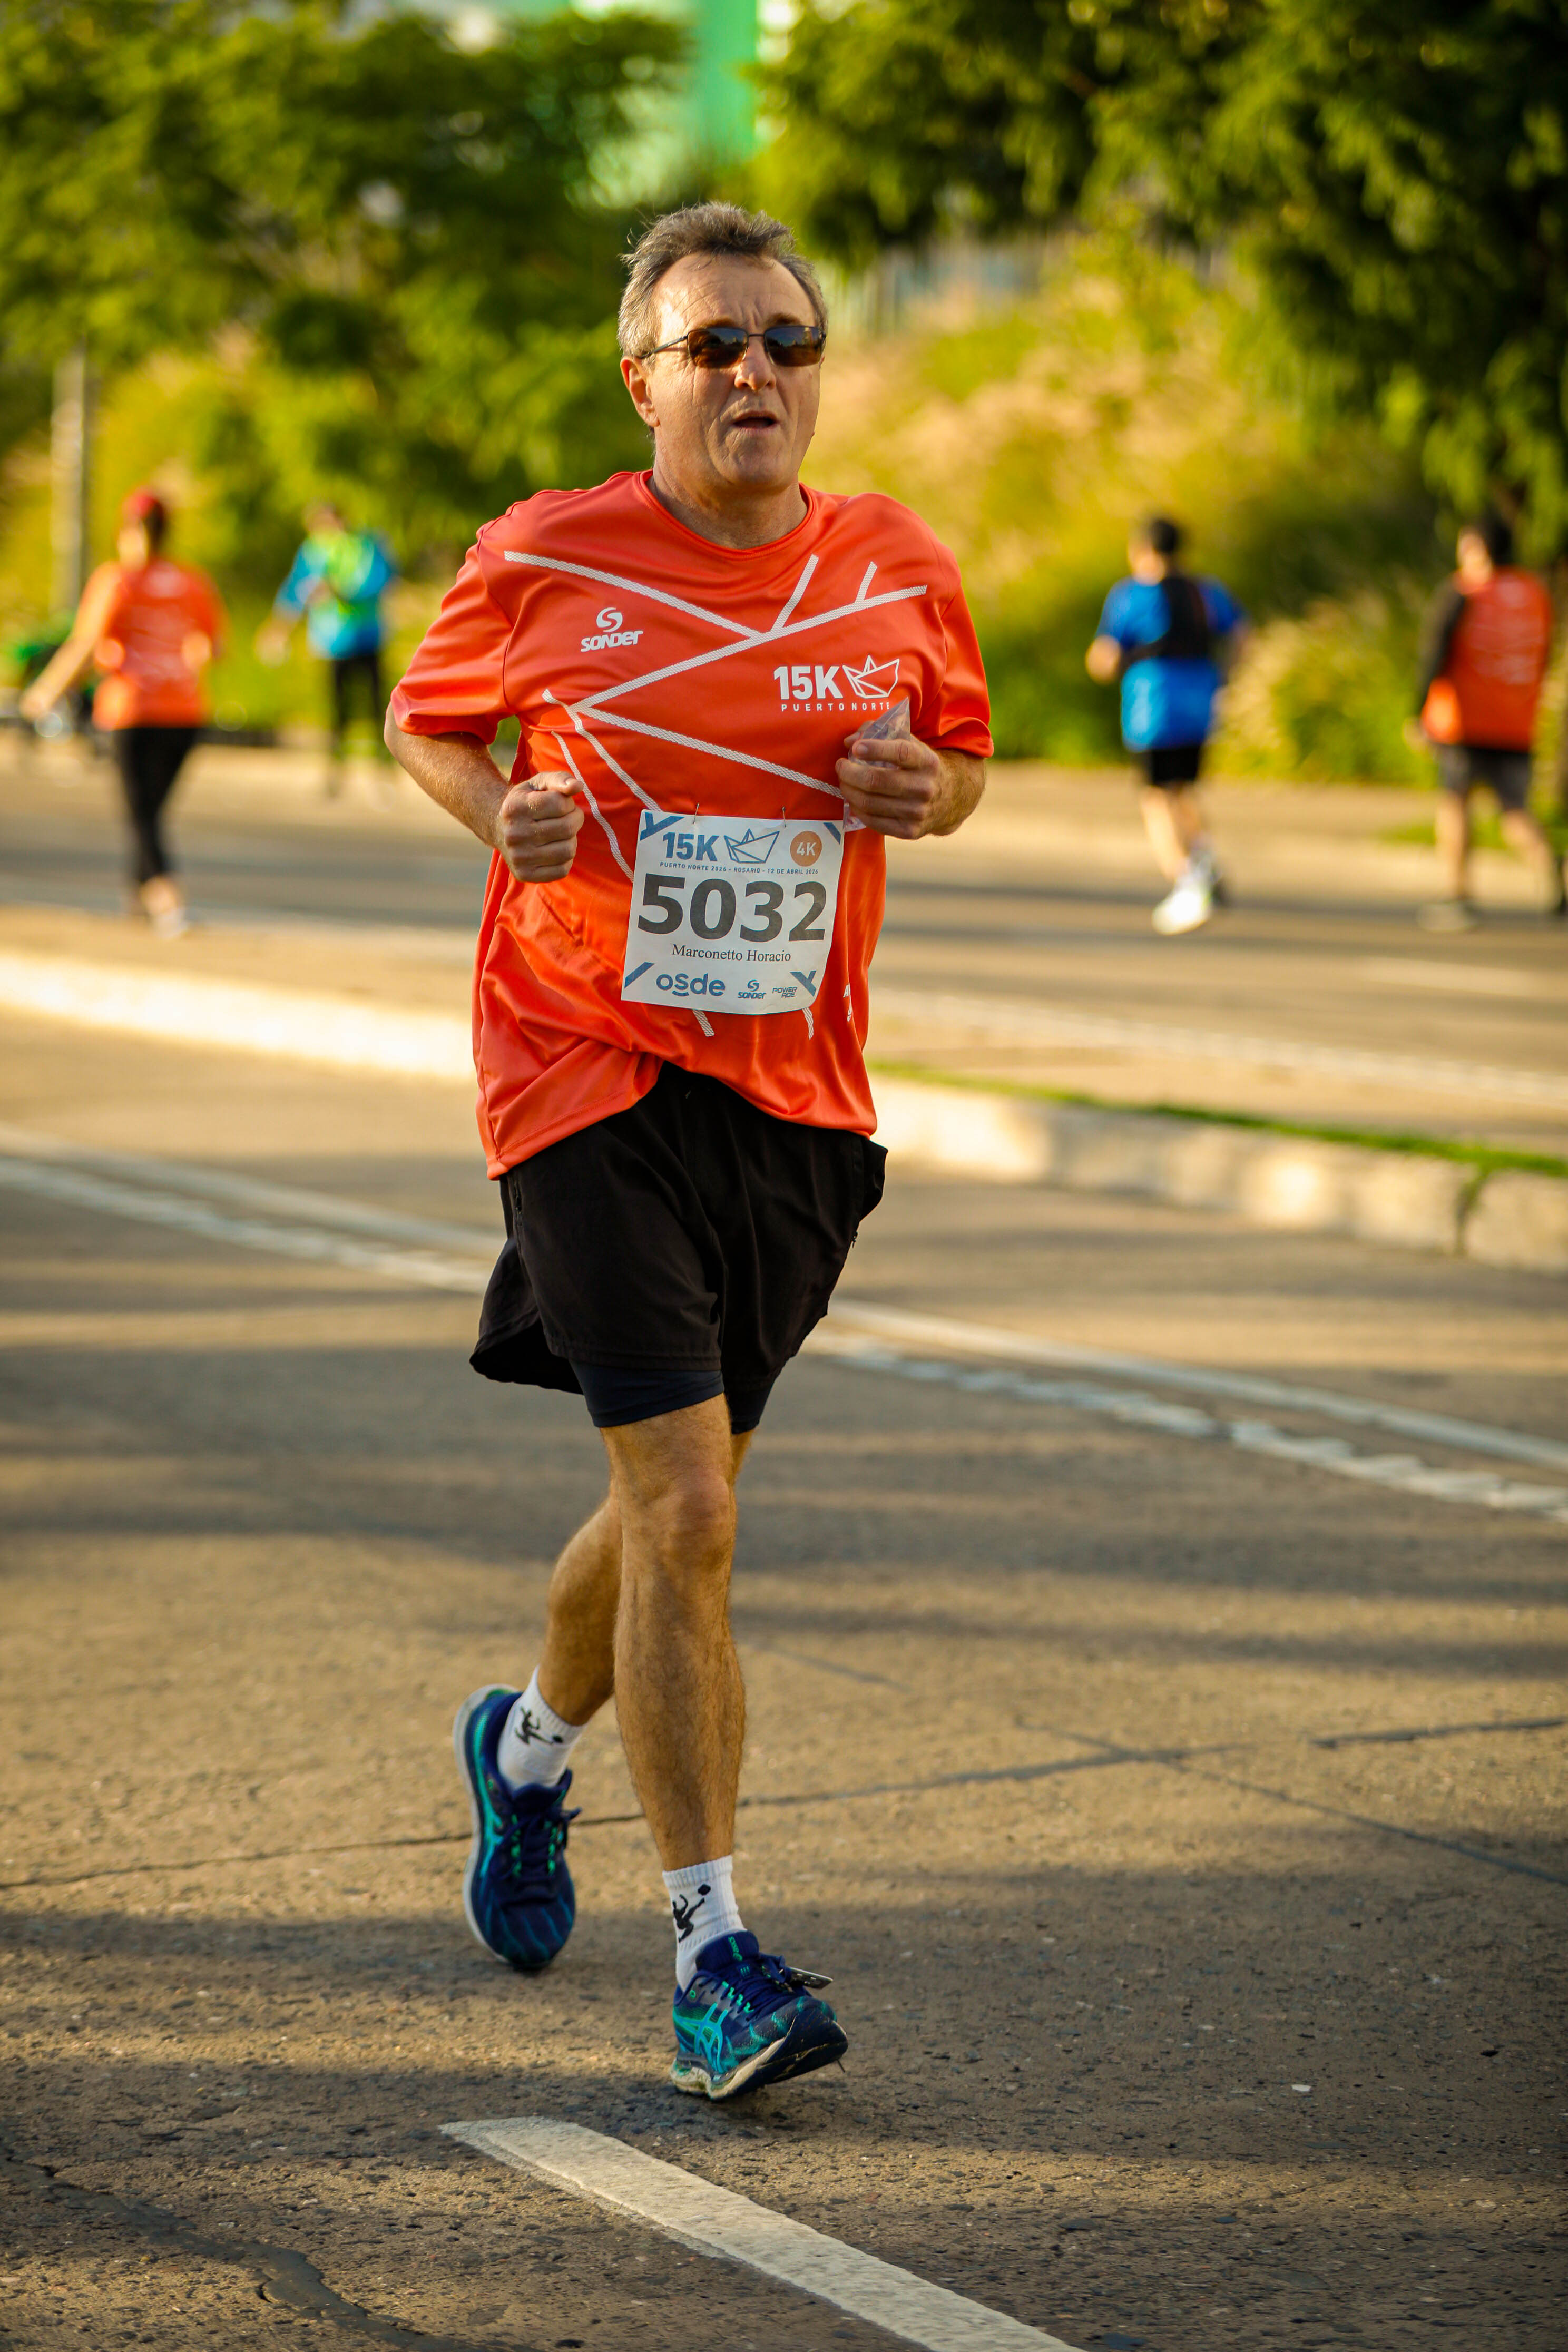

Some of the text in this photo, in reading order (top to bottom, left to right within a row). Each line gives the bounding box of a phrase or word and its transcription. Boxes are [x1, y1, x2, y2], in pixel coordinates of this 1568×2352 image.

[773, 665, 844, 700] 15K
[781, 702, 890, 712] PUERTO NORTE
[662, 831, 720, 862] 15K
[796, 842, 816, 856] 4K
[638, 873, 827, 943] 5032
[672, 944, 791, 962] Marconetto Horacio
[656, 973, 726, 997] osde
